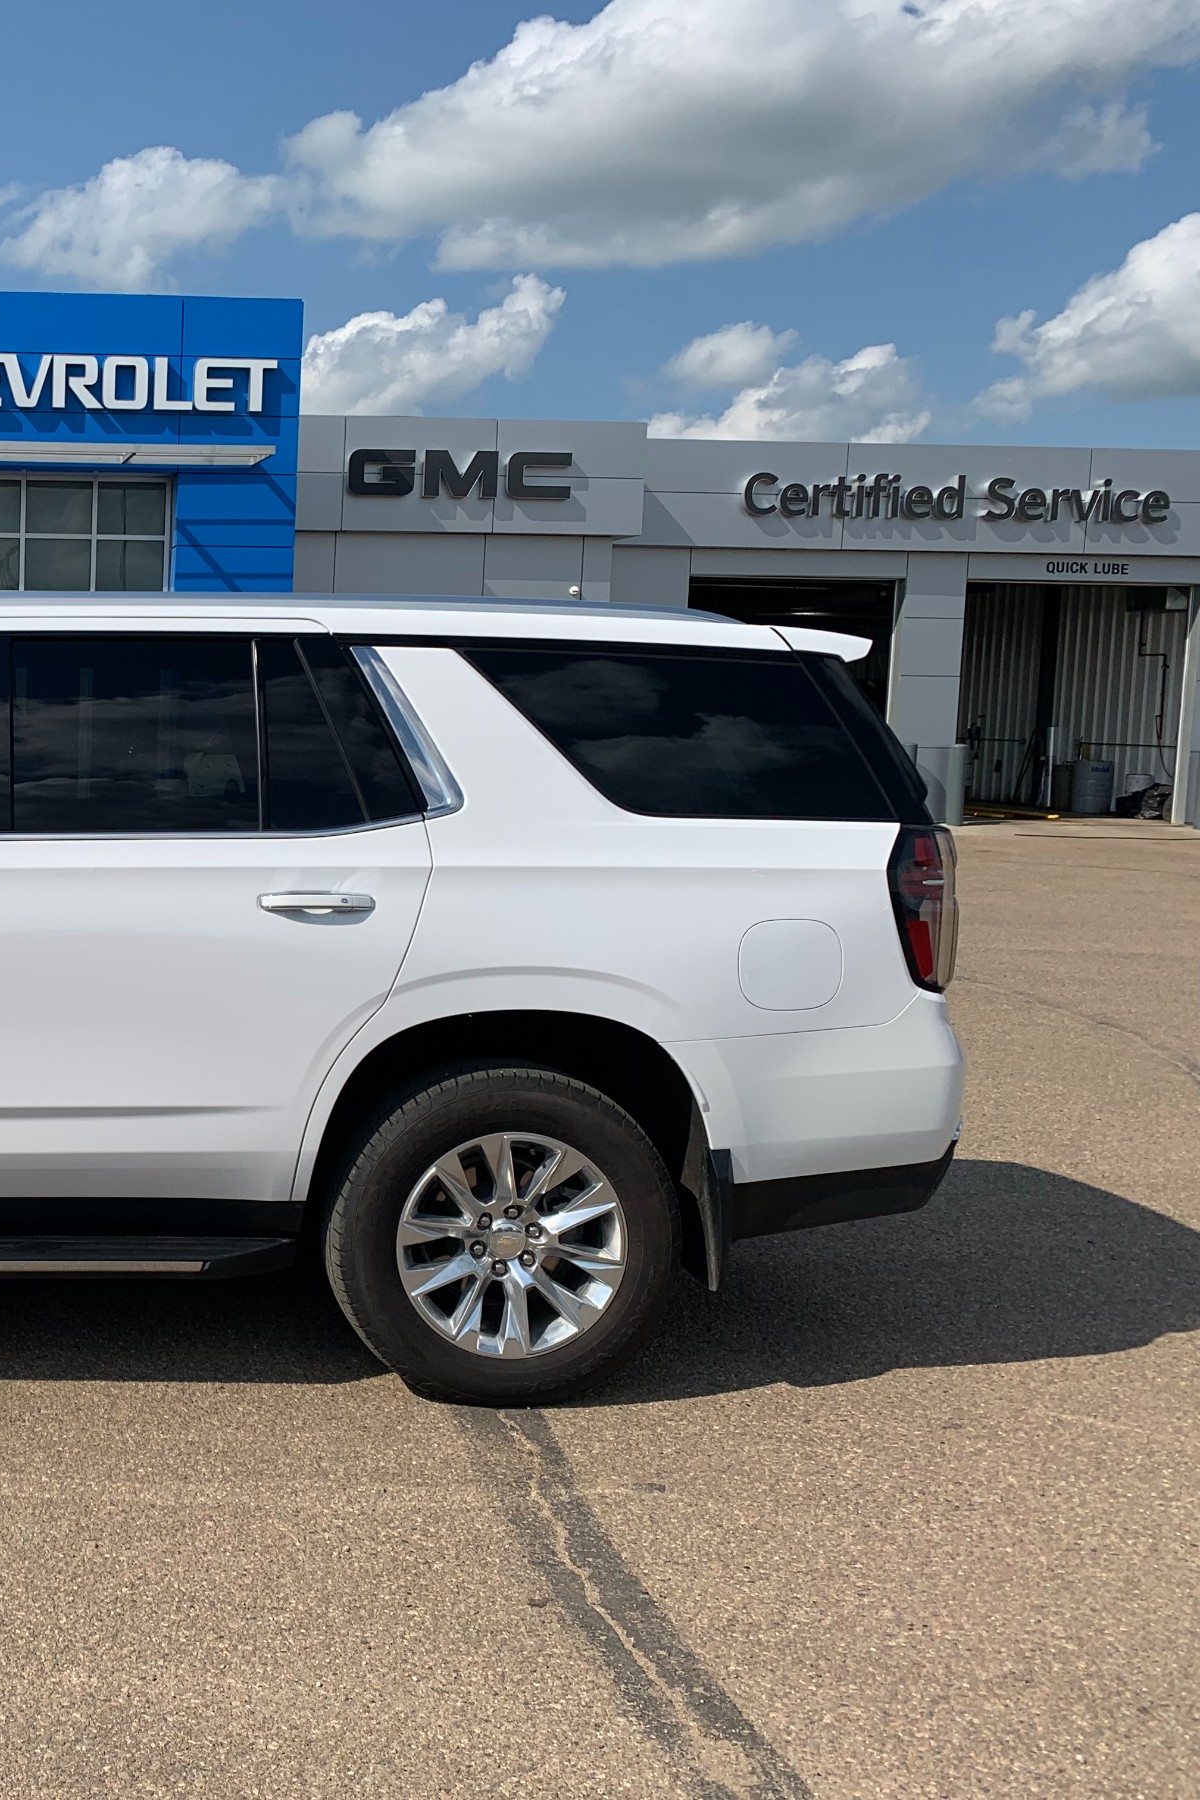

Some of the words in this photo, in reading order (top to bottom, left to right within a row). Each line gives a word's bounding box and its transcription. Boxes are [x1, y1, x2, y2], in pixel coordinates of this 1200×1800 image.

[347, 448, 573, 500] GMC
[744, 472, 967, 519] Certified
[981, 477, 1171, 522] Service
[1046, 561, 1088, 574] QUICK
[1094, 563, 1130, 575] LUBE
